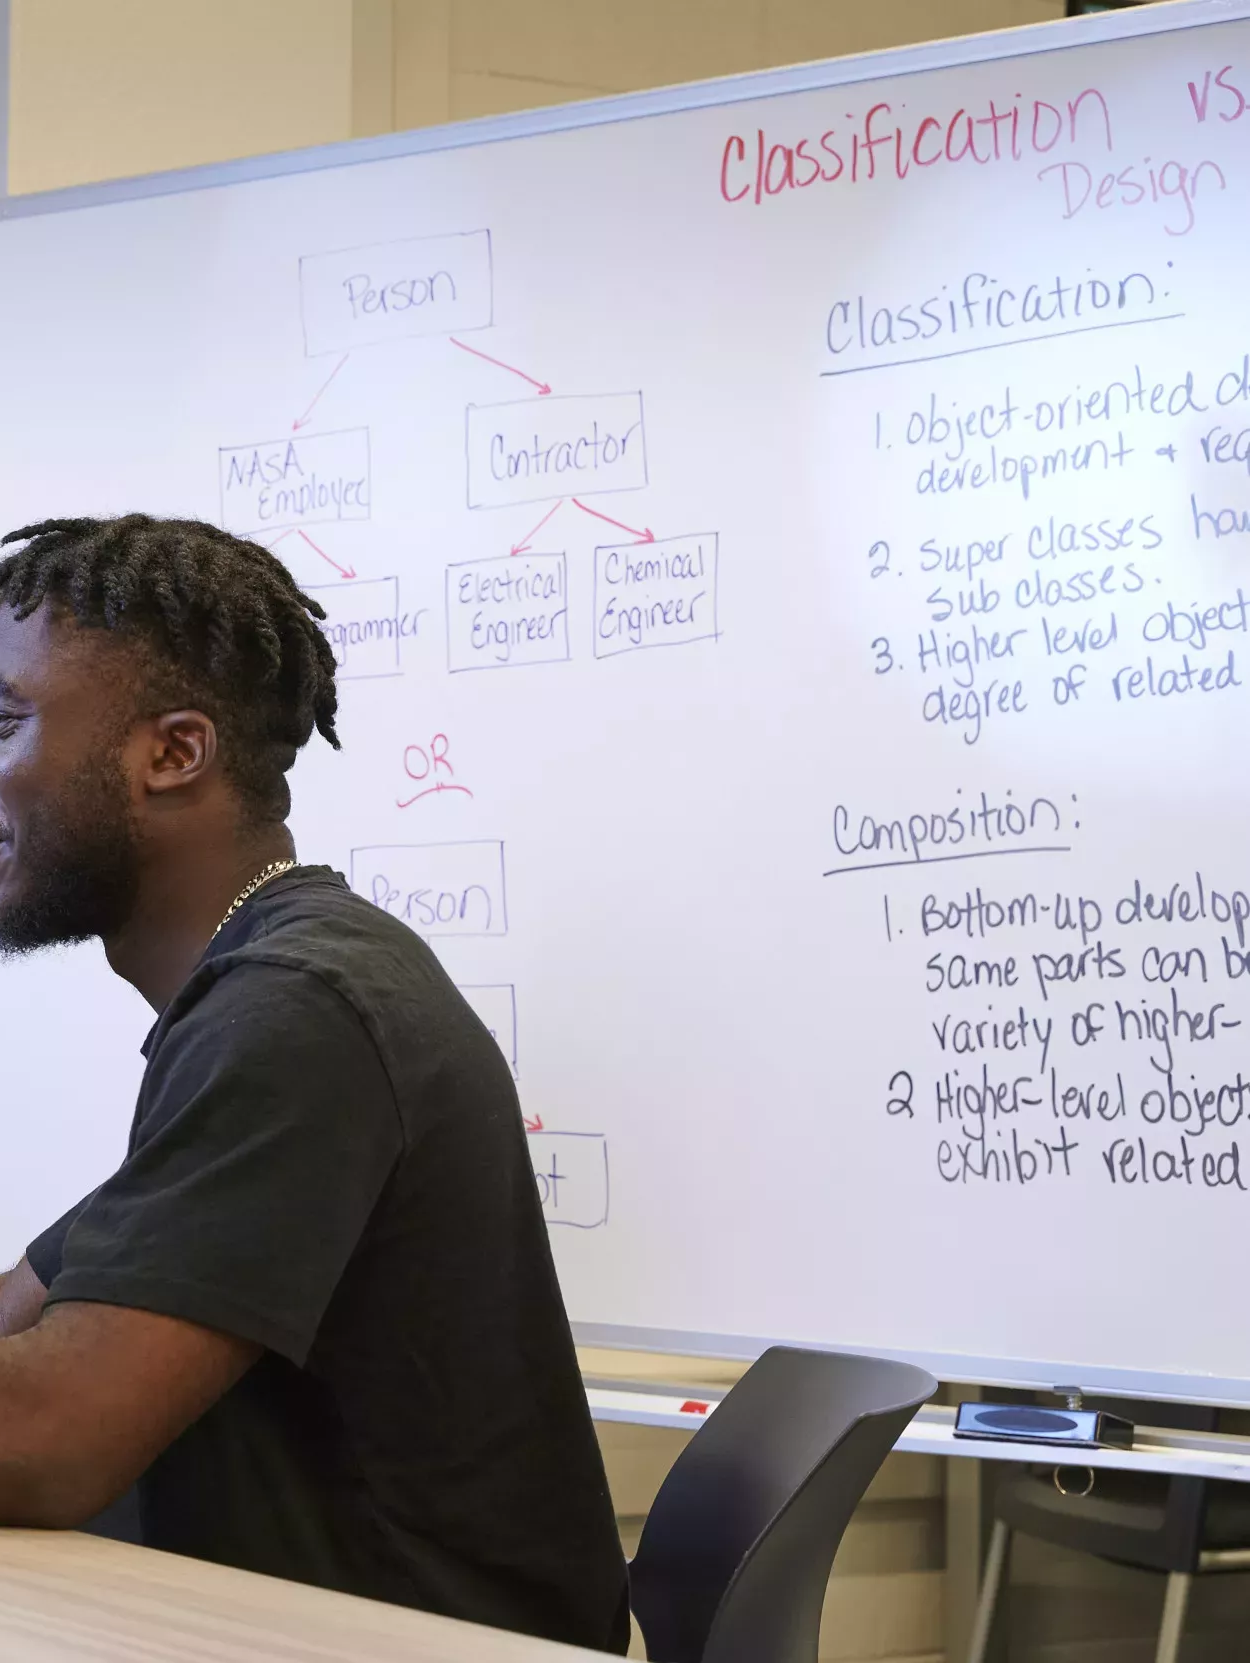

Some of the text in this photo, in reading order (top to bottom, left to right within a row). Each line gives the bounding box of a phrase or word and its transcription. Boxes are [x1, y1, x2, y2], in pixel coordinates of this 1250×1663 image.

[720, 88, 1113, 205] Classification
[1038, 156, 1227, 237] Design
[342, 269, 457, 320] Person
[225, 440, 305, 491] NASA
[489, 420, 642, 484] Contractor
[916, 430, 1135, 500] development
[457, 559, 565, 605] Electrical
[603, 544, 706, 586] Chemical
[469, 606, 569, 663] Engineer
[598, 590, 707, 645] Engineer
[917, 623, 1029, 689] Higher
[1040, 611, 1119, 656] level
[921, 649, 1243, 746] degree of related
[402, 732, 454, 781] OR
[832, 787, 1081, 862] Composition:
[920, 886, 1103, 946] Bottom-up
[1115, 870, 1250, 950] develop
[925, 952, 1020, 993] same
[1031, 940, 1127, 1001] parts
[1140, 946, 1208, 984] can
[931, 986, 1242, 1075] variety of higher-
[885, 1069, 915, 1120] 2
[1140, 1072, 1250, 1137] object
[937, 1125, 1249, 1192] exhibit related
